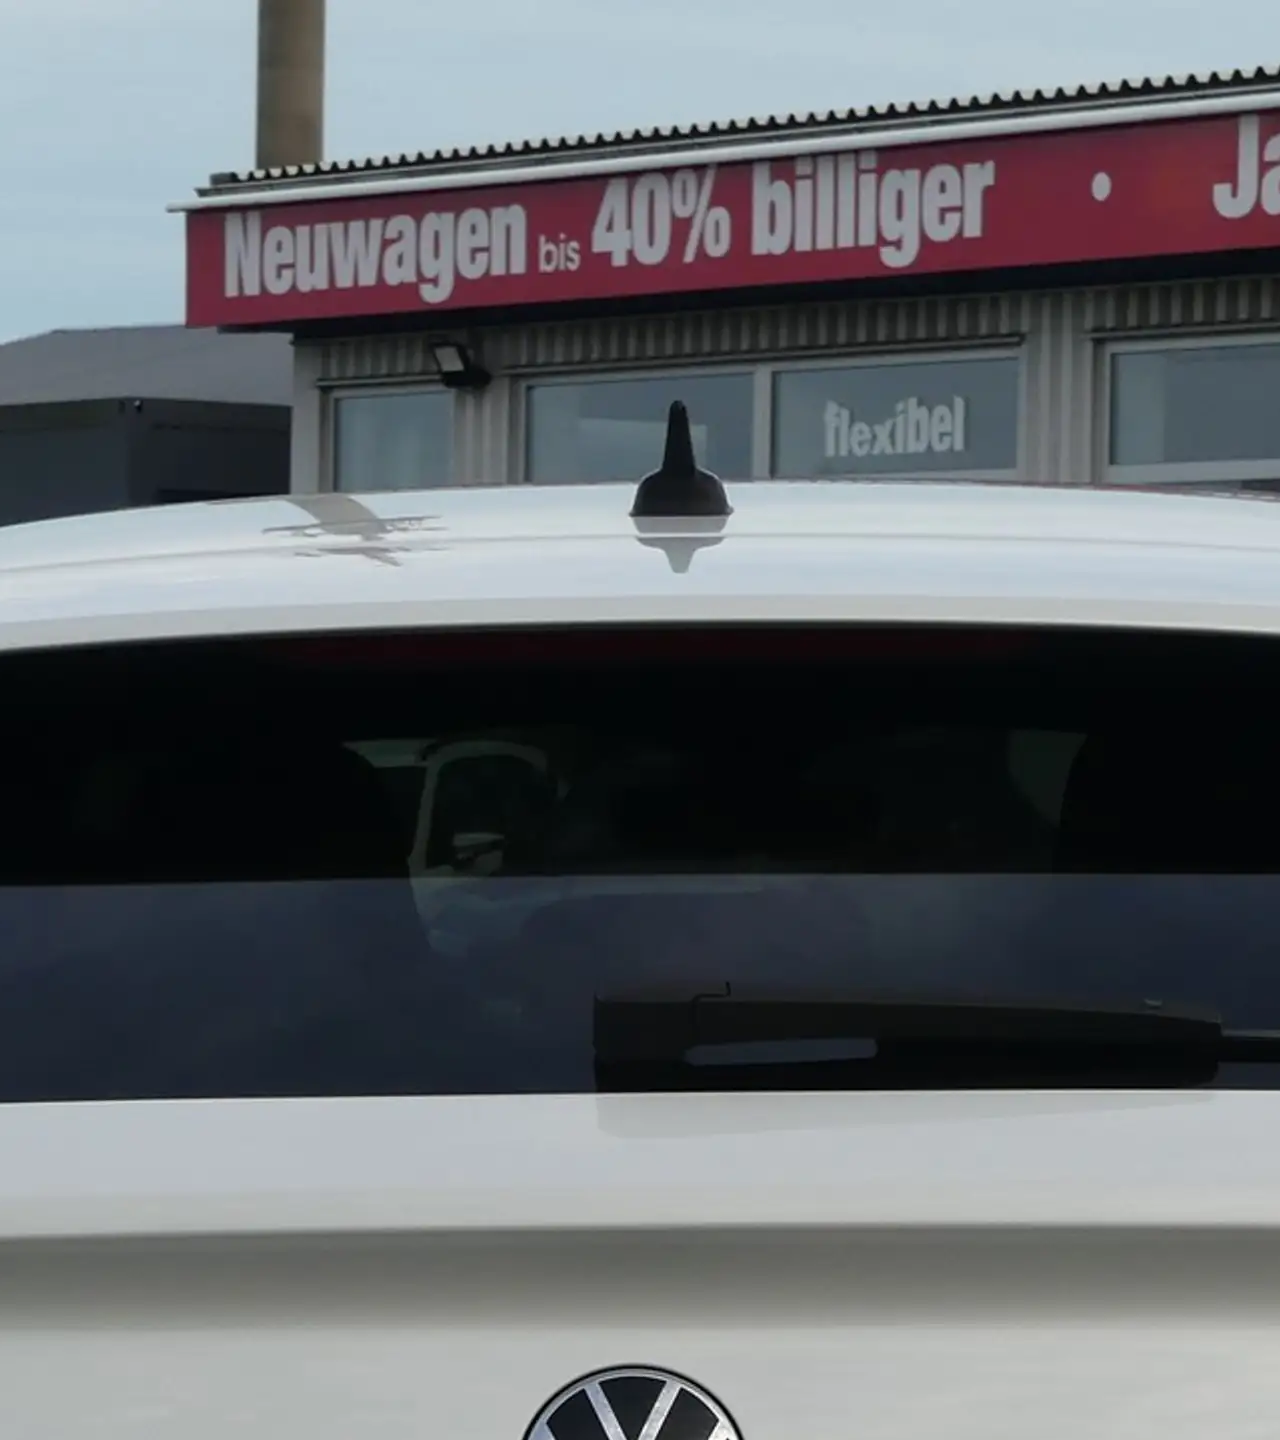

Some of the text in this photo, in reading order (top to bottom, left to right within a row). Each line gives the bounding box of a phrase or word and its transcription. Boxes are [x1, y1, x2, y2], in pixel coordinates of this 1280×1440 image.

[224, 203, 527, 304] Neuwagen
[538, 232, 581, 273] bis
[591, 163, 732, 268] 40%
[751, 151, 996, 269] billiger
[824, 393, 966, 458] flexibel
